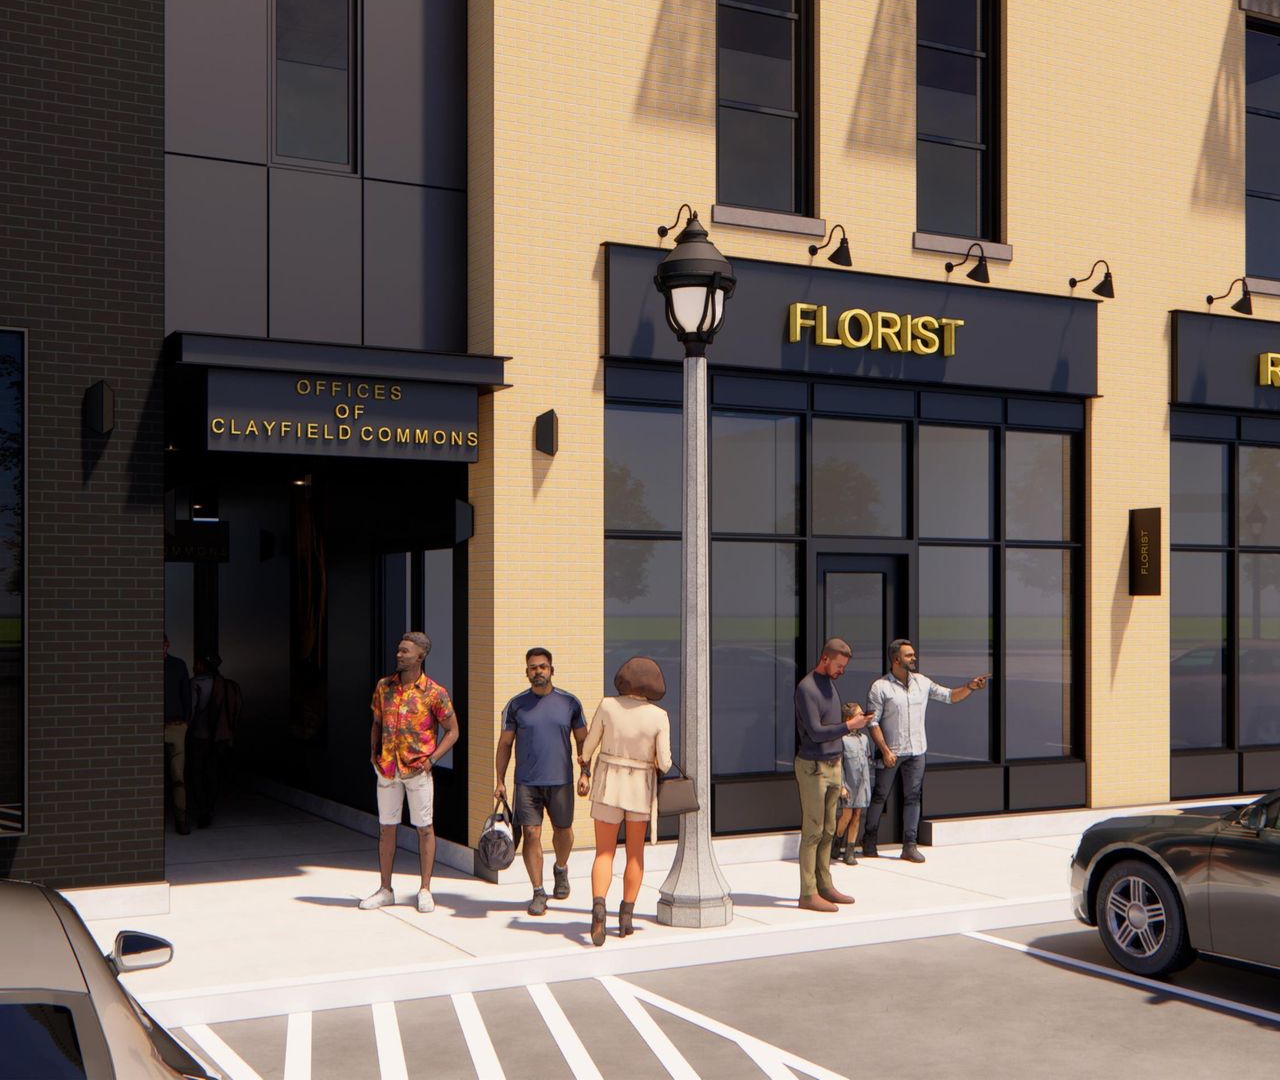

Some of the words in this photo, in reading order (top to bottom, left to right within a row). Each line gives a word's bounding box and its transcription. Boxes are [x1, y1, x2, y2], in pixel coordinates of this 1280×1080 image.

[788, 302, 964, 357] FLORIST
[296, 378, 402, 400] OFFICES
[335, 403, 365, 420] OF
[211, 418, 352, 440] CLAYFIELD
[360, 425, 478, 447] COMMONS
[1140, 528, 1150, 575] FLORIST
